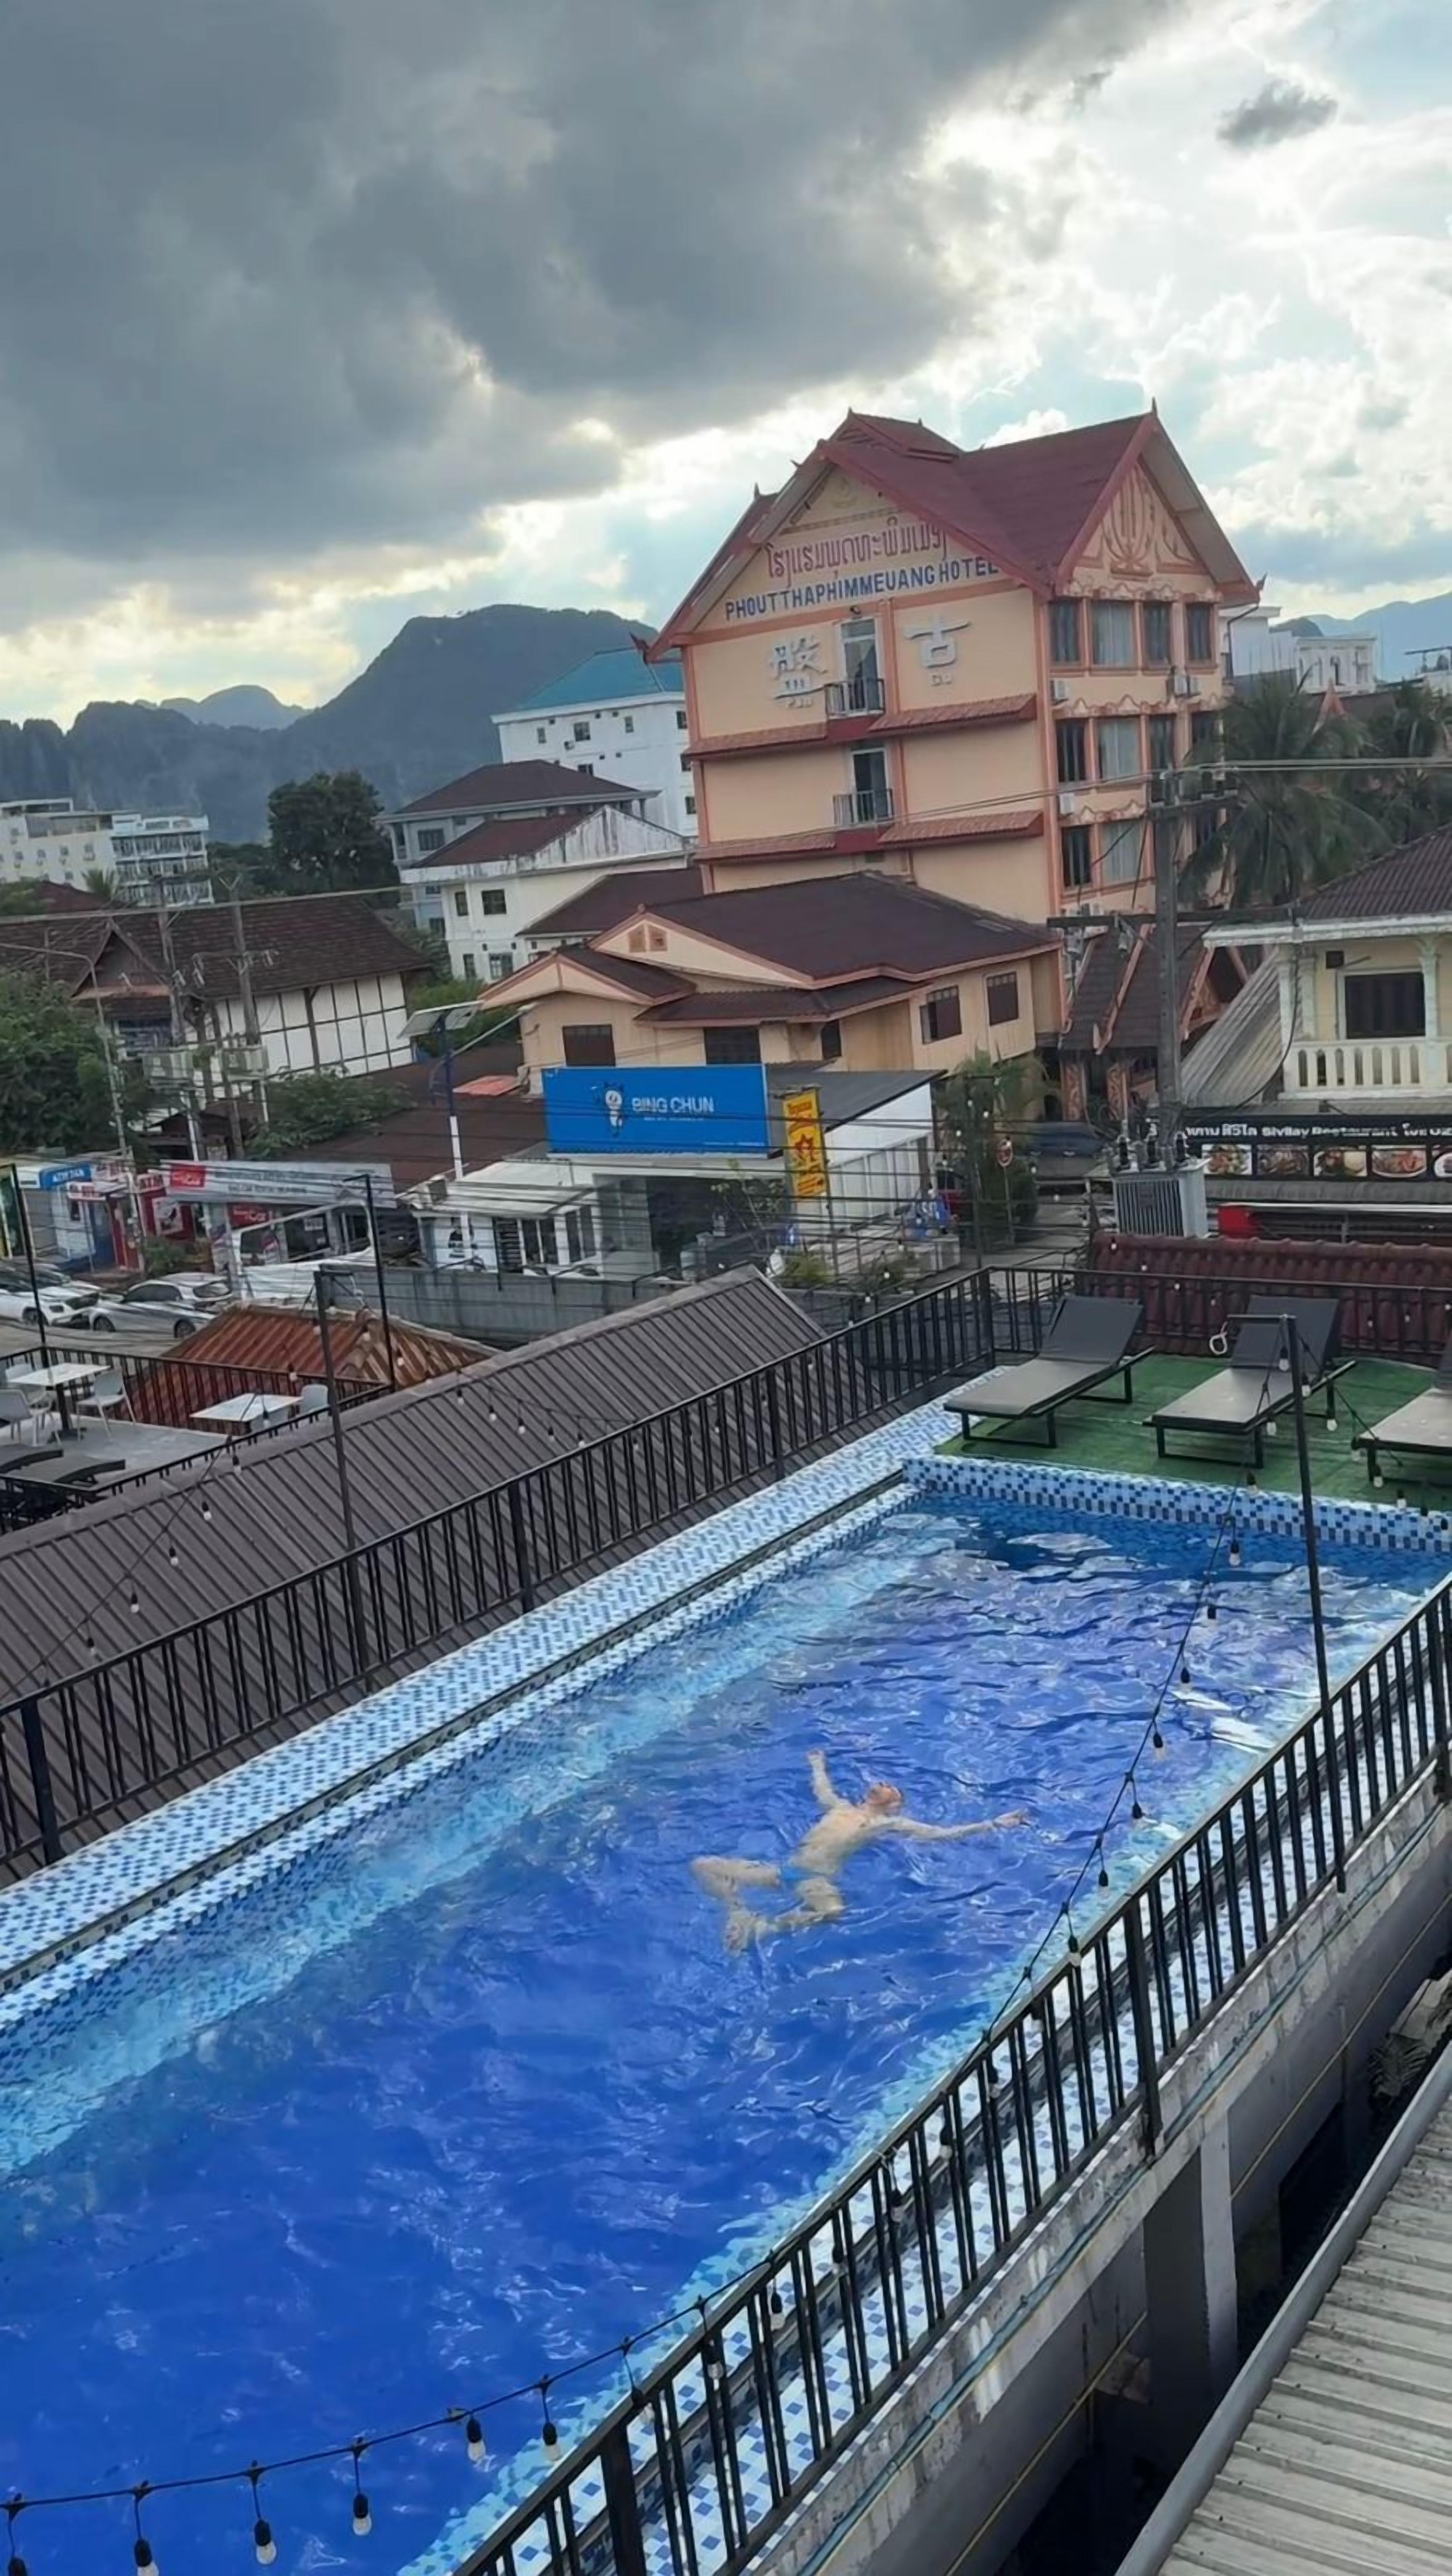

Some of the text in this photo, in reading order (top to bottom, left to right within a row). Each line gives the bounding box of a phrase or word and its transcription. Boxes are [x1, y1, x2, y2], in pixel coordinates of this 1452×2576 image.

[725, 556, 999, 621] PHOUTTHAPHIMMEUANG HOTEL
[631, 1096, 714, 1114] BING CHUN
